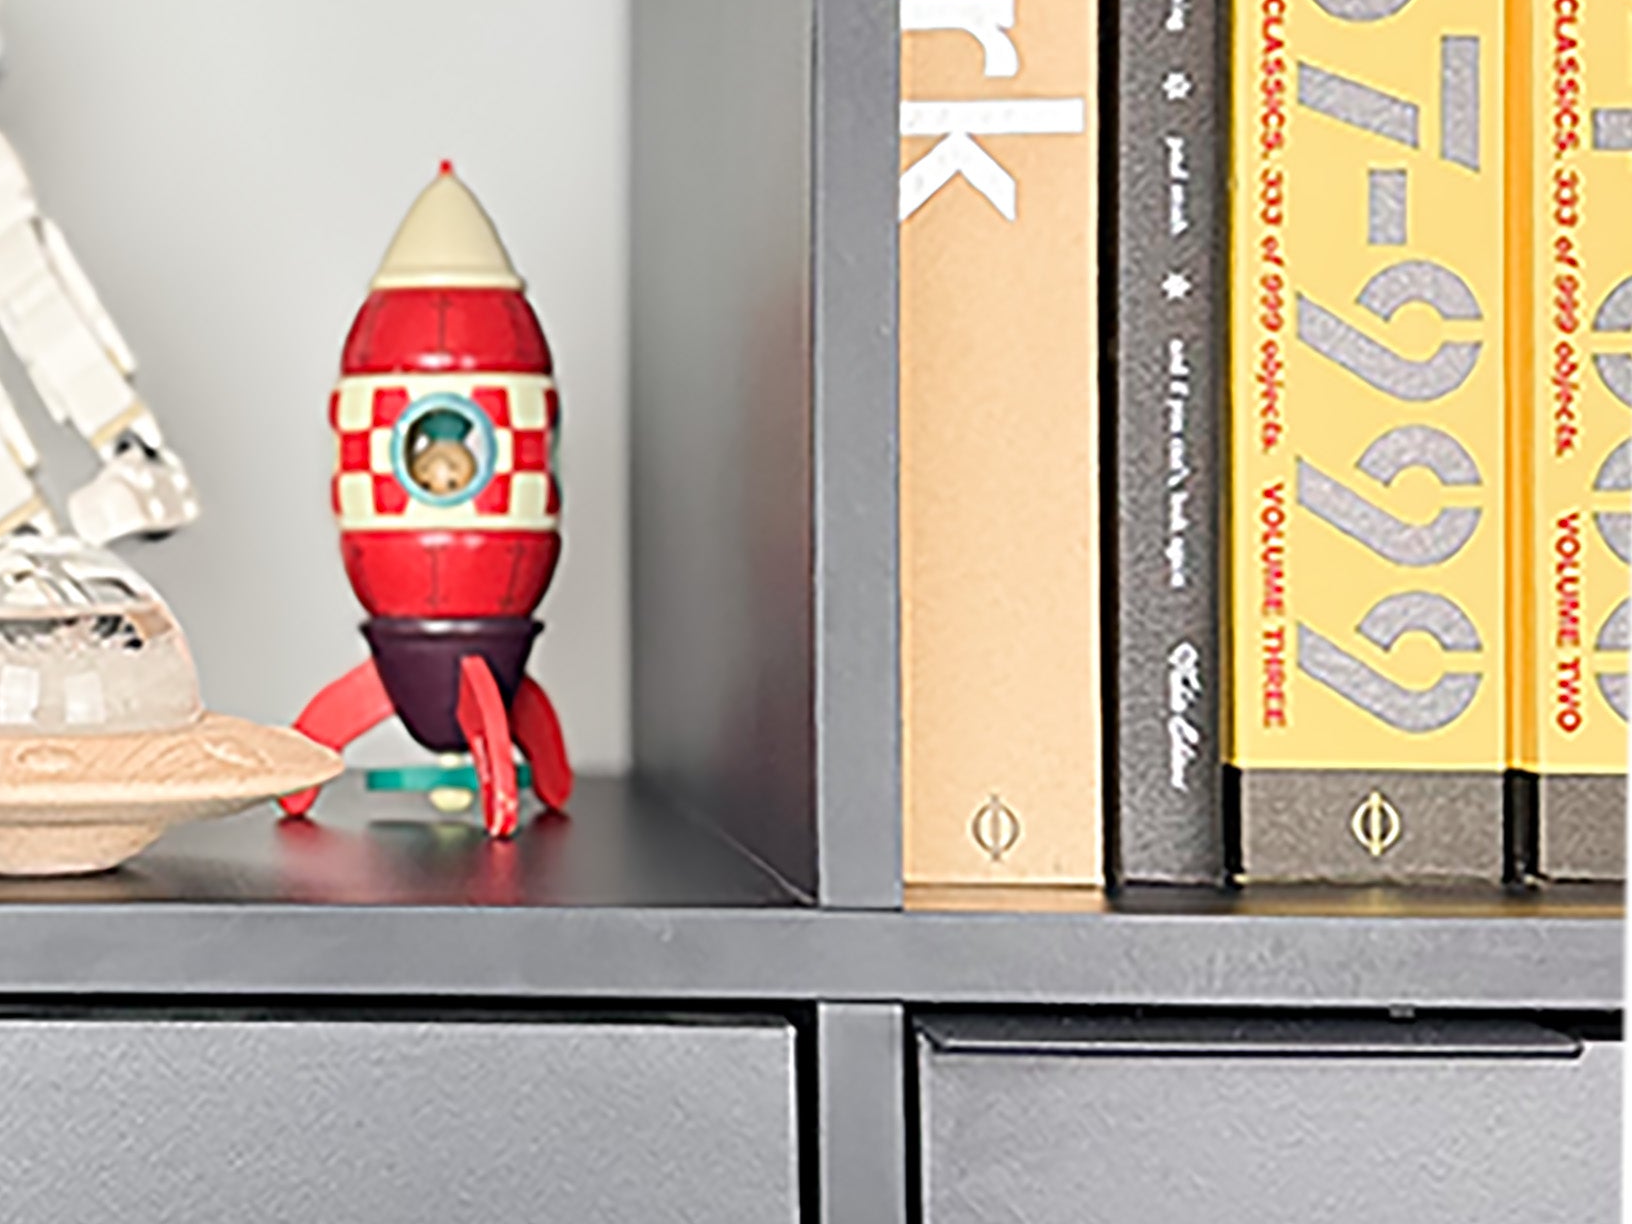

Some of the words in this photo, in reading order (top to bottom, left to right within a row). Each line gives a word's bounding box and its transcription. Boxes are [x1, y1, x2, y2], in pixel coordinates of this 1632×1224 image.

[1261, 169, 1285, 226] 333
[1553, 169, 1577, 226] 333
[1261, 236, 1286, 267] of
[1553, 236, 1578, 267] of
[1261, 274, 1284, 334] 999
[1553, 274, 1576, 334] 999
[1256, 340, 1285, 455] objects.
[1548, 340, 1577, 456] objects.
[1261, 482, 1286, 616] VOLUME
[1554, 512, 1581, 647] VOLUME
[1263, 626, 1287, 729] THREE
[1556, 657, 1582, 734] TWO
